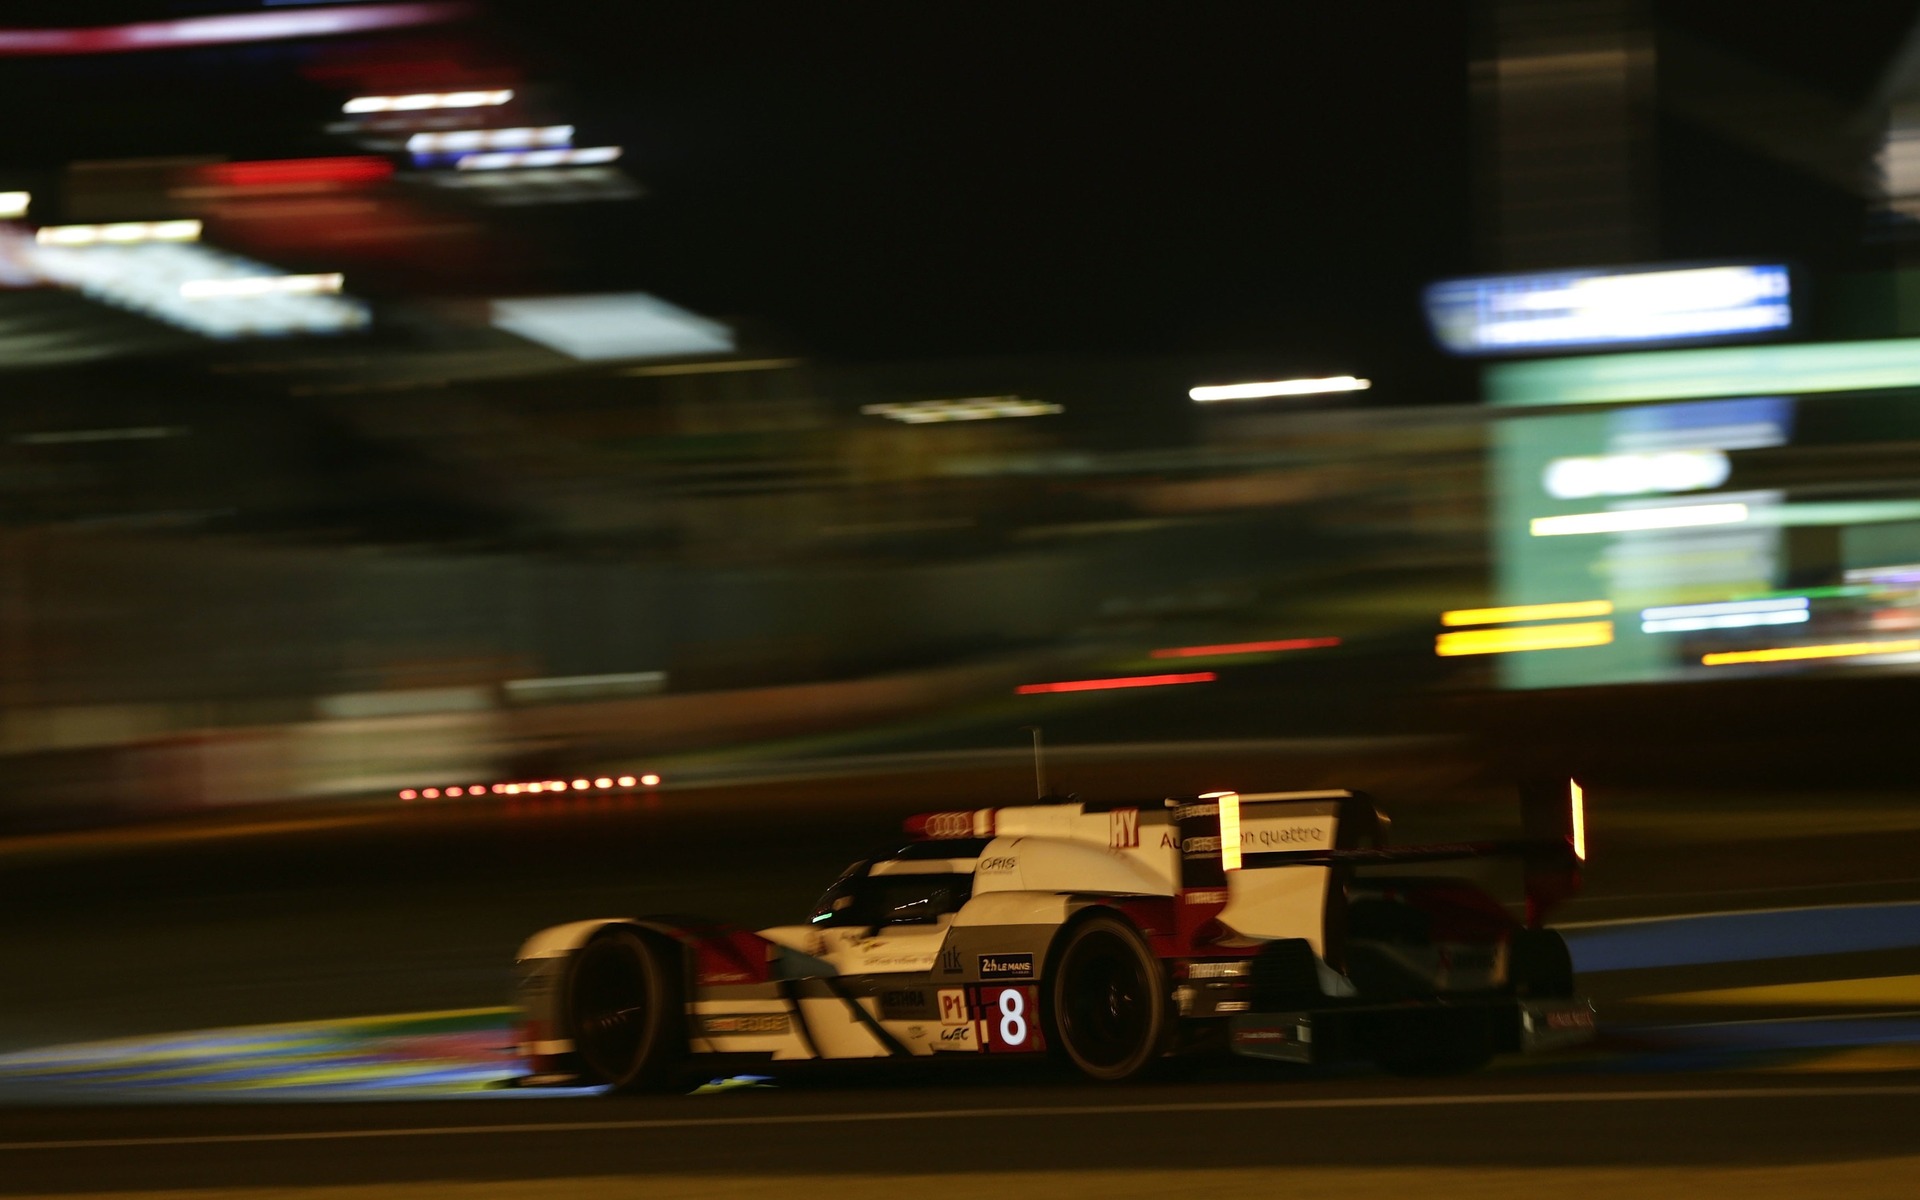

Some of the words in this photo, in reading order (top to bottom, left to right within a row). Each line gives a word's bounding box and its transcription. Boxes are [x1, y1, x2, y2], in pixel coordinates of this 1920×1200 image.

[1109, 810, 1138, 847] HY
[1259, 827, 1323, 846] quattro
[980, 857, 1016, 870] ORIS
[998, 963, 1007, 972] LE
[1008, 962, 1031, 971] MANS
[942, 995, 962, 1019] P1
[999, 988, 1027, 1046] 8
[941, 1027, 969, 1041] WEC
